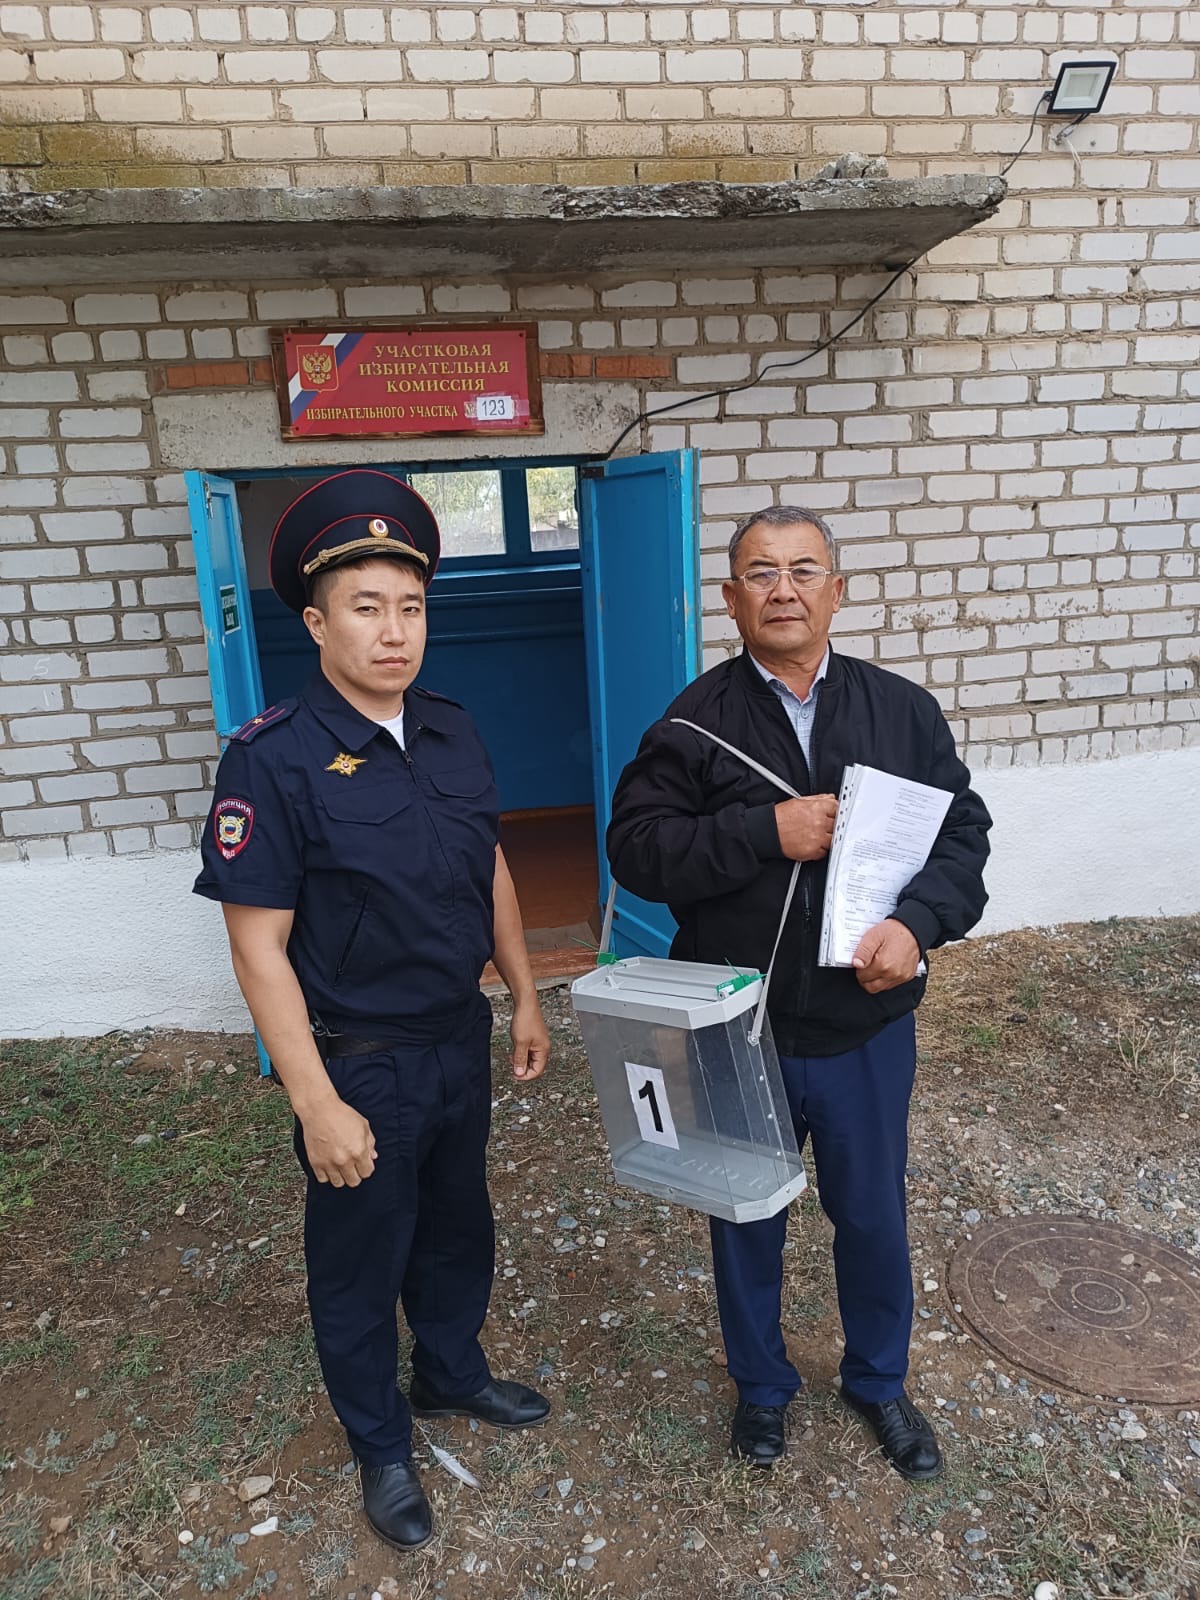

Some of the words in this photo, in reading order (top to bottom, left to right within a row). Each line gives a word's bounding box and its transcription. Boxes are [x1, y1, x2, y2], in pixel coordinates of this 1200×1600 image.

[375, 344, 492, 358] УЧАСТКОВАЯ
[359, 361, 510, 376] ИЗБИРАТЕЛЬНАЯ
[386, 378, 486, 393] КОМИССИЯ
[306, 406, 405, 420] ИЗБИРАТЕЛЬНОГО
[410, 404, 458, 418] УЧАСТКА
[482, 399, 506, 416] 123
[217, 801, 251, 816] ПОЛИЦИЯ
[638, 1080, 664, 1133] 1
